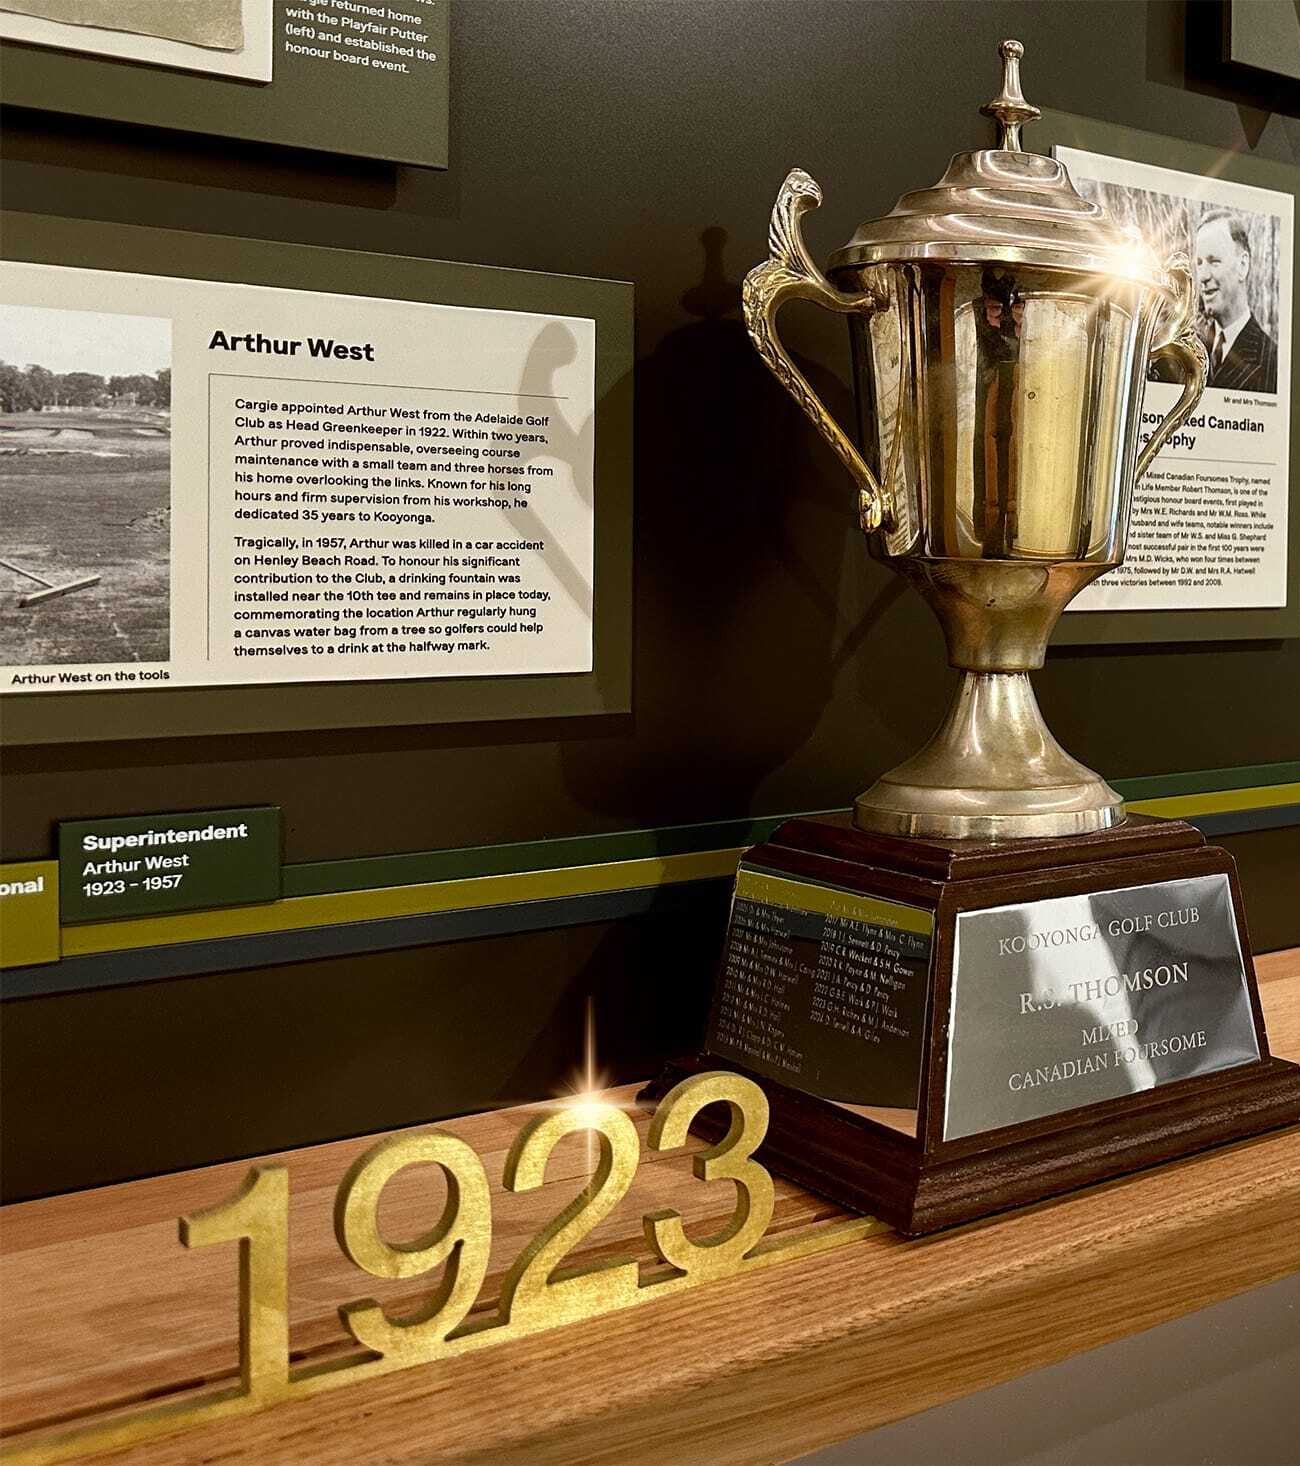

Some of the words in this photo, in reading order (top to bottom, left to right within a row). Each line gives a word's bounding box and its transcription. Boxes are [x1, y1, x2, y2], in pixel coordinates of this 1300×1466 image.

[285, 7, 314, 21] with
[316, 12, 338, 25] the
[341, 16, 388, 35] Playfair
[390, 26, 428, 43] Putter
[331, 0, 386, 18] returned
[387, 8, 422, 25] home
[285, 22, 315, 39] (left)
[317, 31, 341, 43] and
[344, 36, 414, 57] established
[415, 48, 436, 61] the
[285, 40, 331, 59] honour
[333, 49, 369, 66] board
[371, 59, 409, 74] event.
[208, 330, 302, 356] Arthur
[307, 337, 374, 362] West
[234, 398, 278, 413] Cargie
[281, 402, 344, 415] appointed
[346, 405, 387, 417] Arthur
[389, 407, 420, 419] West
[422, 409, 450, 421] from
[453, 411, 472, 422] the
[474, 412, 523, 425] Adelaide
[525, 415, 549, 427] Golf
[1242, 398, 1253, 406] Mrs
[1253, 398, 1277, 407] Thomson
[234, 416, 265, 429] Club
[268, 420, 283, 430] as
[286, 419, 319, 431] Head
[322, 421, 403, 437] Greenkeeper
[405, 425, 416, 436] in
[418, 426, 449, 438] 1922.
[452, 428, 488, 440] Within
[491, 431, 513, 441] two
[514, 433, 548, 445] years,
[1208, 416, 1265, 433] Canadian
[234, 435, 278, 447] Arthur
[280, 438, 324, 450] proved
[327, 439, 413, 455] indispensable,
[416, 445, 479, 459] overseeing
[481, 448, 520, 458] course
[234, 453, 319, 467] maintenance
[321, 456, 349, 468] with
[352, 460, 359, 468] a
[362, 459, 394, 470] small
[396, 460, 427, 471] team
[430, 461, 451, 472] and
[454, 462, 485, 473] three
[487, 463, 525, 475] horses
[527, 464, 553, 476] from
[234, 471, 253, 483] his
[256, 472, 293, 484] home
[296, 474, 368, 489] overlooking
[371, 476, 392, 487] the
[394, 476, 424, 488] links.
[427, 478, 467, 490] Known
[470, 479, 487, 490] for
[489, 479, 505, 491] his
[507, 480, 531, 494] long
[1141, 482, 1154, 491] Life
[1154, 483, 1181, 492] Member
[1181, 484, 1203, 493] Robert
[1204, 485, 1233, 495] Thomson,
[1251, 487, 1258, 496] of
[1258, 488, 1268, 496] the
[1145, 469, 1165, 480] Mixed
[1165, 472, 1195, 481] Canadian
[1195, 473, 1229, 483] Foursomes
[1229, 475, 1250, 486] Trophy,
[1160, 495, 1183, 504] honour
[1183, 496, 1202, 505] board
[1202, 498, 1224, 506] events,
[1224, 498, 1237, 506] first
[1238, 500, 1257, 509] played
[1143, 542, 1177, 551] successful
[1177, 543, 1189, 553] pair
[1190, 543, 1196, 551] in
[1196, 543, 1207, 551] the
[1207, 543, 1220, 552] first
[1221, 543, 1232, 552] 100
[1233, 545, 1249, 554] years
[11, 673, 56, 685] Arthur
[58, 672, 92, 683] West
[95, 673, 111, 682] on
[114, 670, 136, 681] the
[138, 669, 170, 681] tools
[83, 823, 248, 853] Superintendent
[82, 859, 141, 876] Arthur
[144, 854, 189, 870] West
[82, 880, 125, 897] 1923
[142, 874, 183, 891] 1957
[998, 925, 1102, 956] KOOYONGA
[1109, 914, 1154, 938] GOLF
[1157, 907, 1200, 928] CLUB
[1019, 988, 1062, 1015] R.S.
[1068, 962, 1190, 1004] THOMSON
[1081, 1019, 1139, 1047] MIXED
[1008, 1053, 1109, 1092] CANADIAN
[1114, 1031, 1207, 1066] FOURSOME
[178, 1070, 776, 1398] 1923
